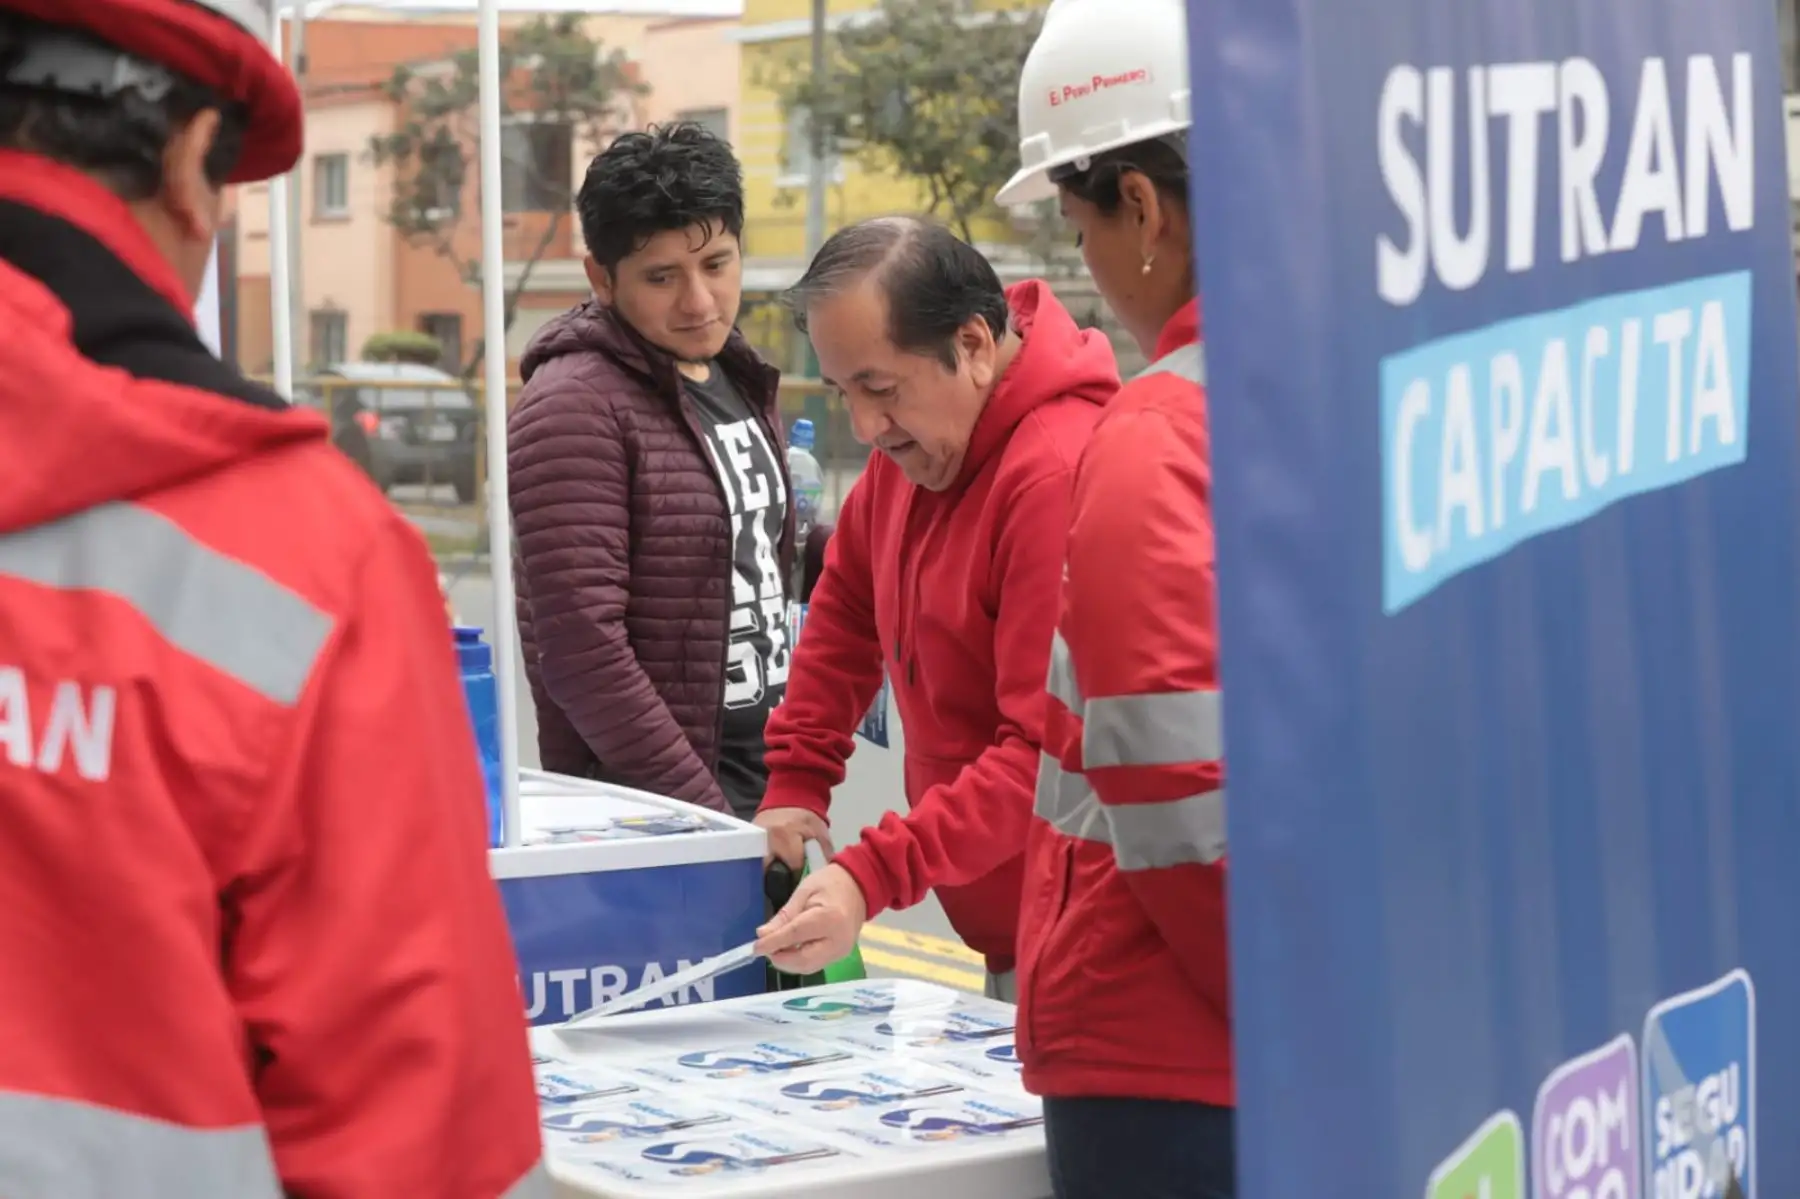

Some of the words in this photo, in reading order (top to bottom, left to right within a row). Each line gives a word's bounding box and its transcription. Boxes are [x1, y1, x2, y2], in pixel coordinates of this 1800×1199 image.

[1376, 52, 1754, 306] SUTRAN
[1394, 300, 1736, 573] CAPACITA
[513, 956, 716, 1019] UTRAN
